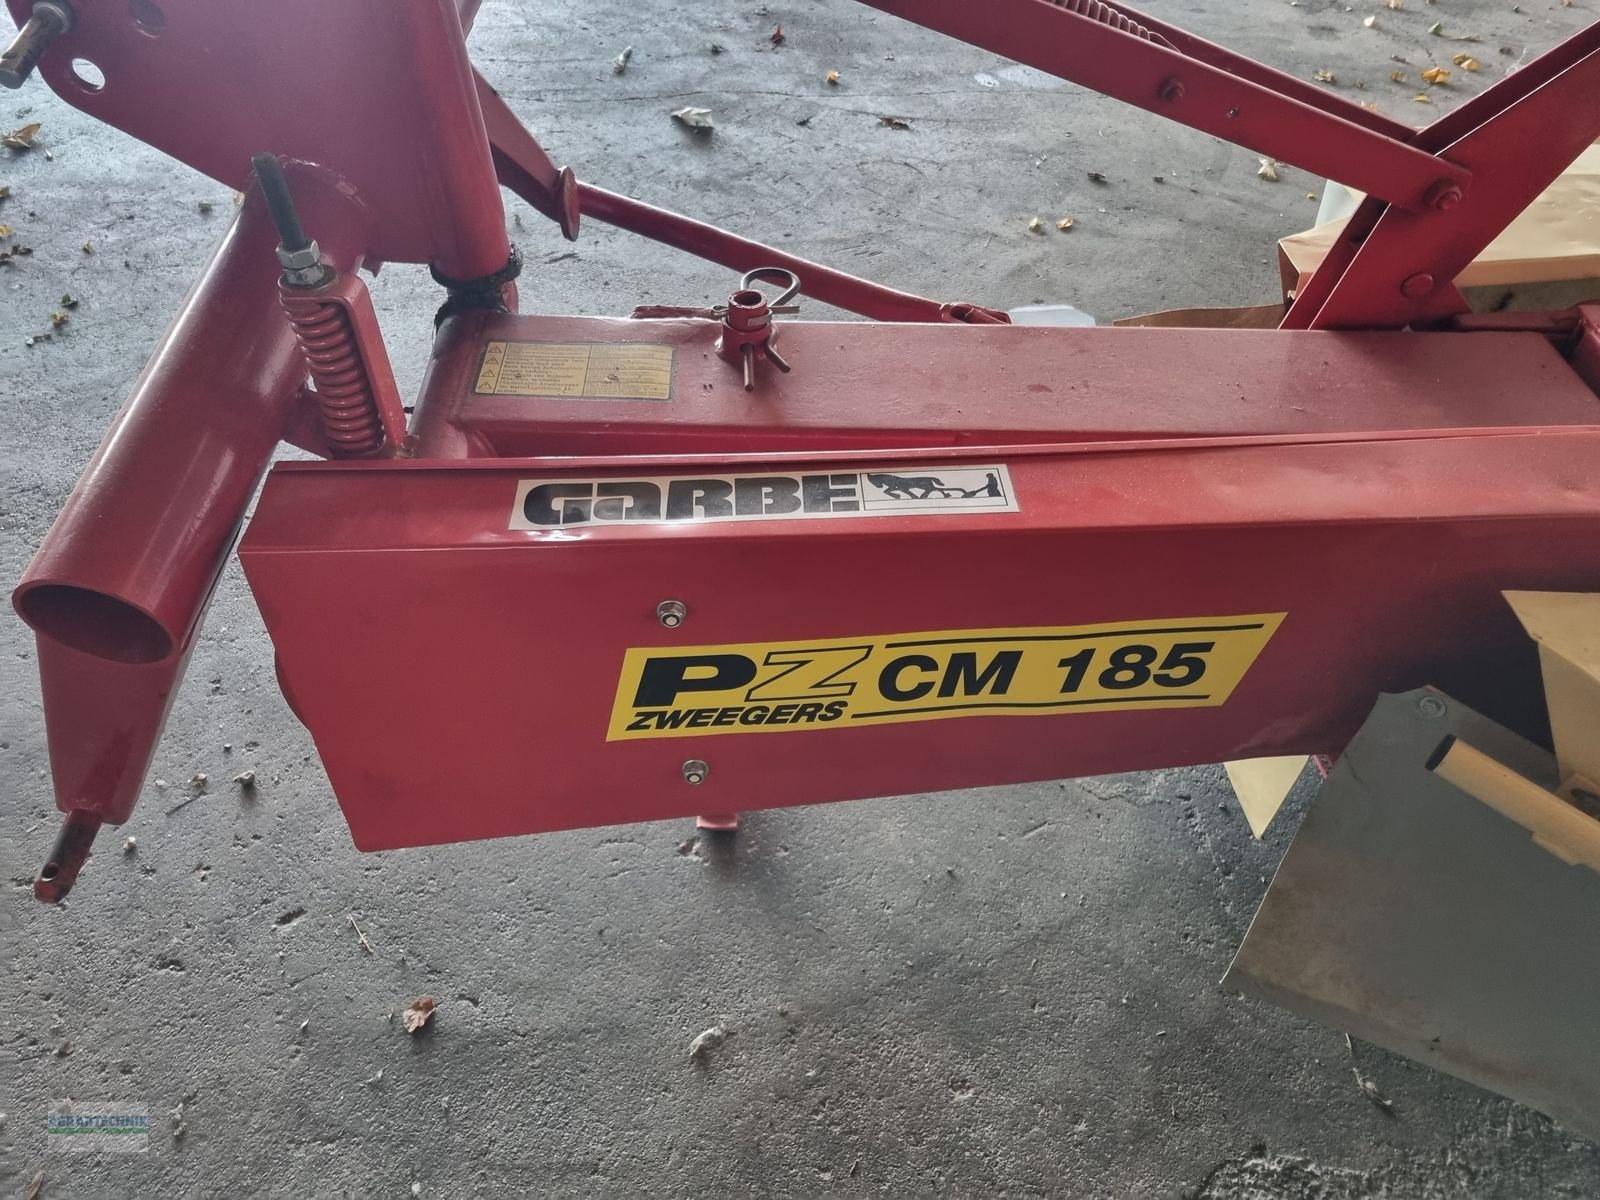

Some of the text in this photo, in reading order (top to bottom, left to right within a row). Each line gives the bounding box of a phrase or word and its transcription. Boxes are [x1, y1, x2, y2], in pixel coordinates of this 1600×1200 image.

[523, 473, 860, 525] GARBE
[632, 641, 1216, 708] PZ CM 185
[625, 701, 849, 731] ZWEEGERS
